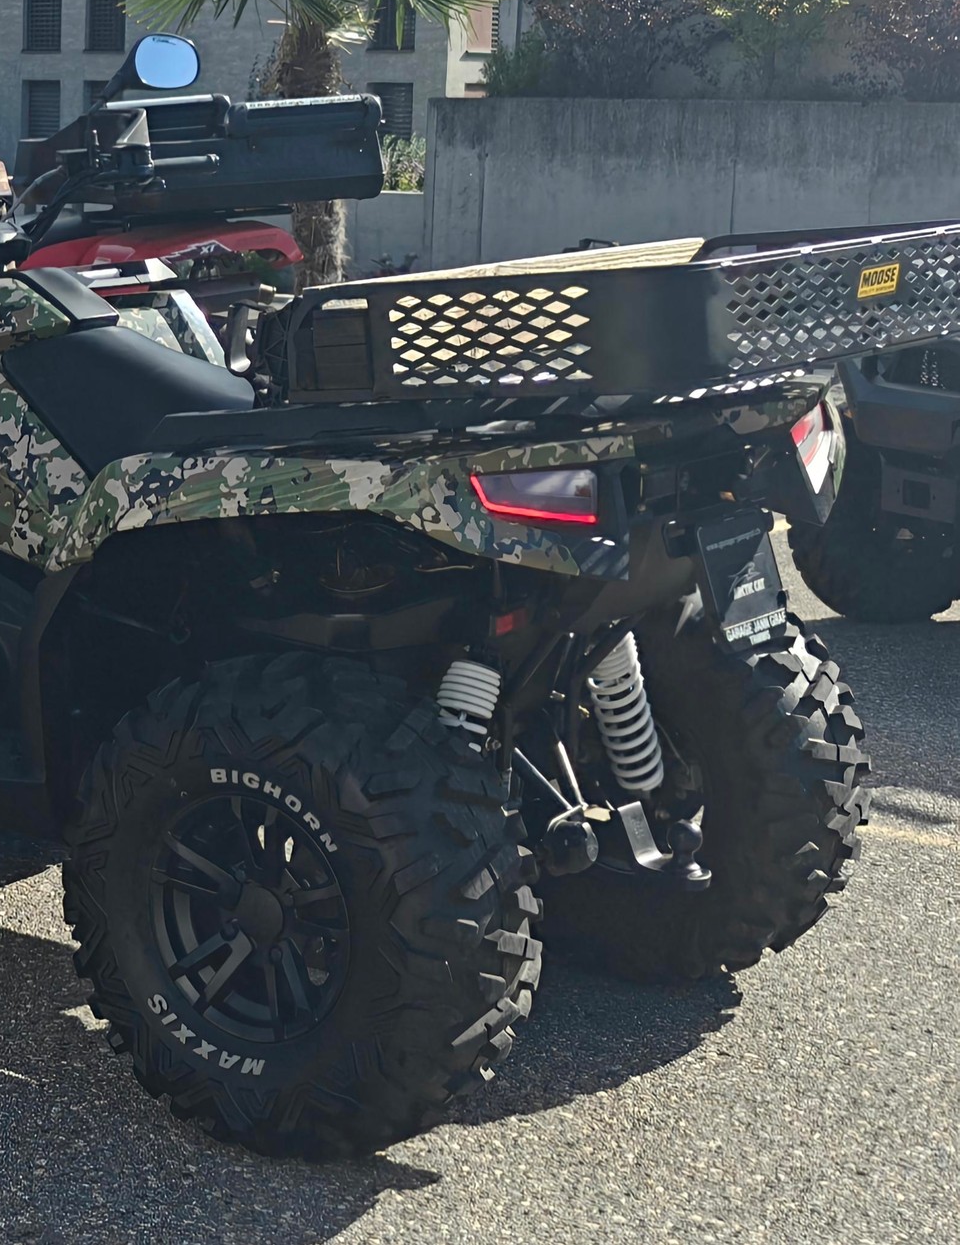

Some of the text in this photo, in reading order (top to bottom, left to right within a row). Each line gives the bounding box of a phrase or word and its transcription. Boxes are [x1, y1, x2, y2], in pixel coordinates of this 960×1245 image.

[861, 267, 897, 288] MOOSE
[210, 768, 338, 853] BIGHORN
[147, 994, 266, 1076] MAXXIS
